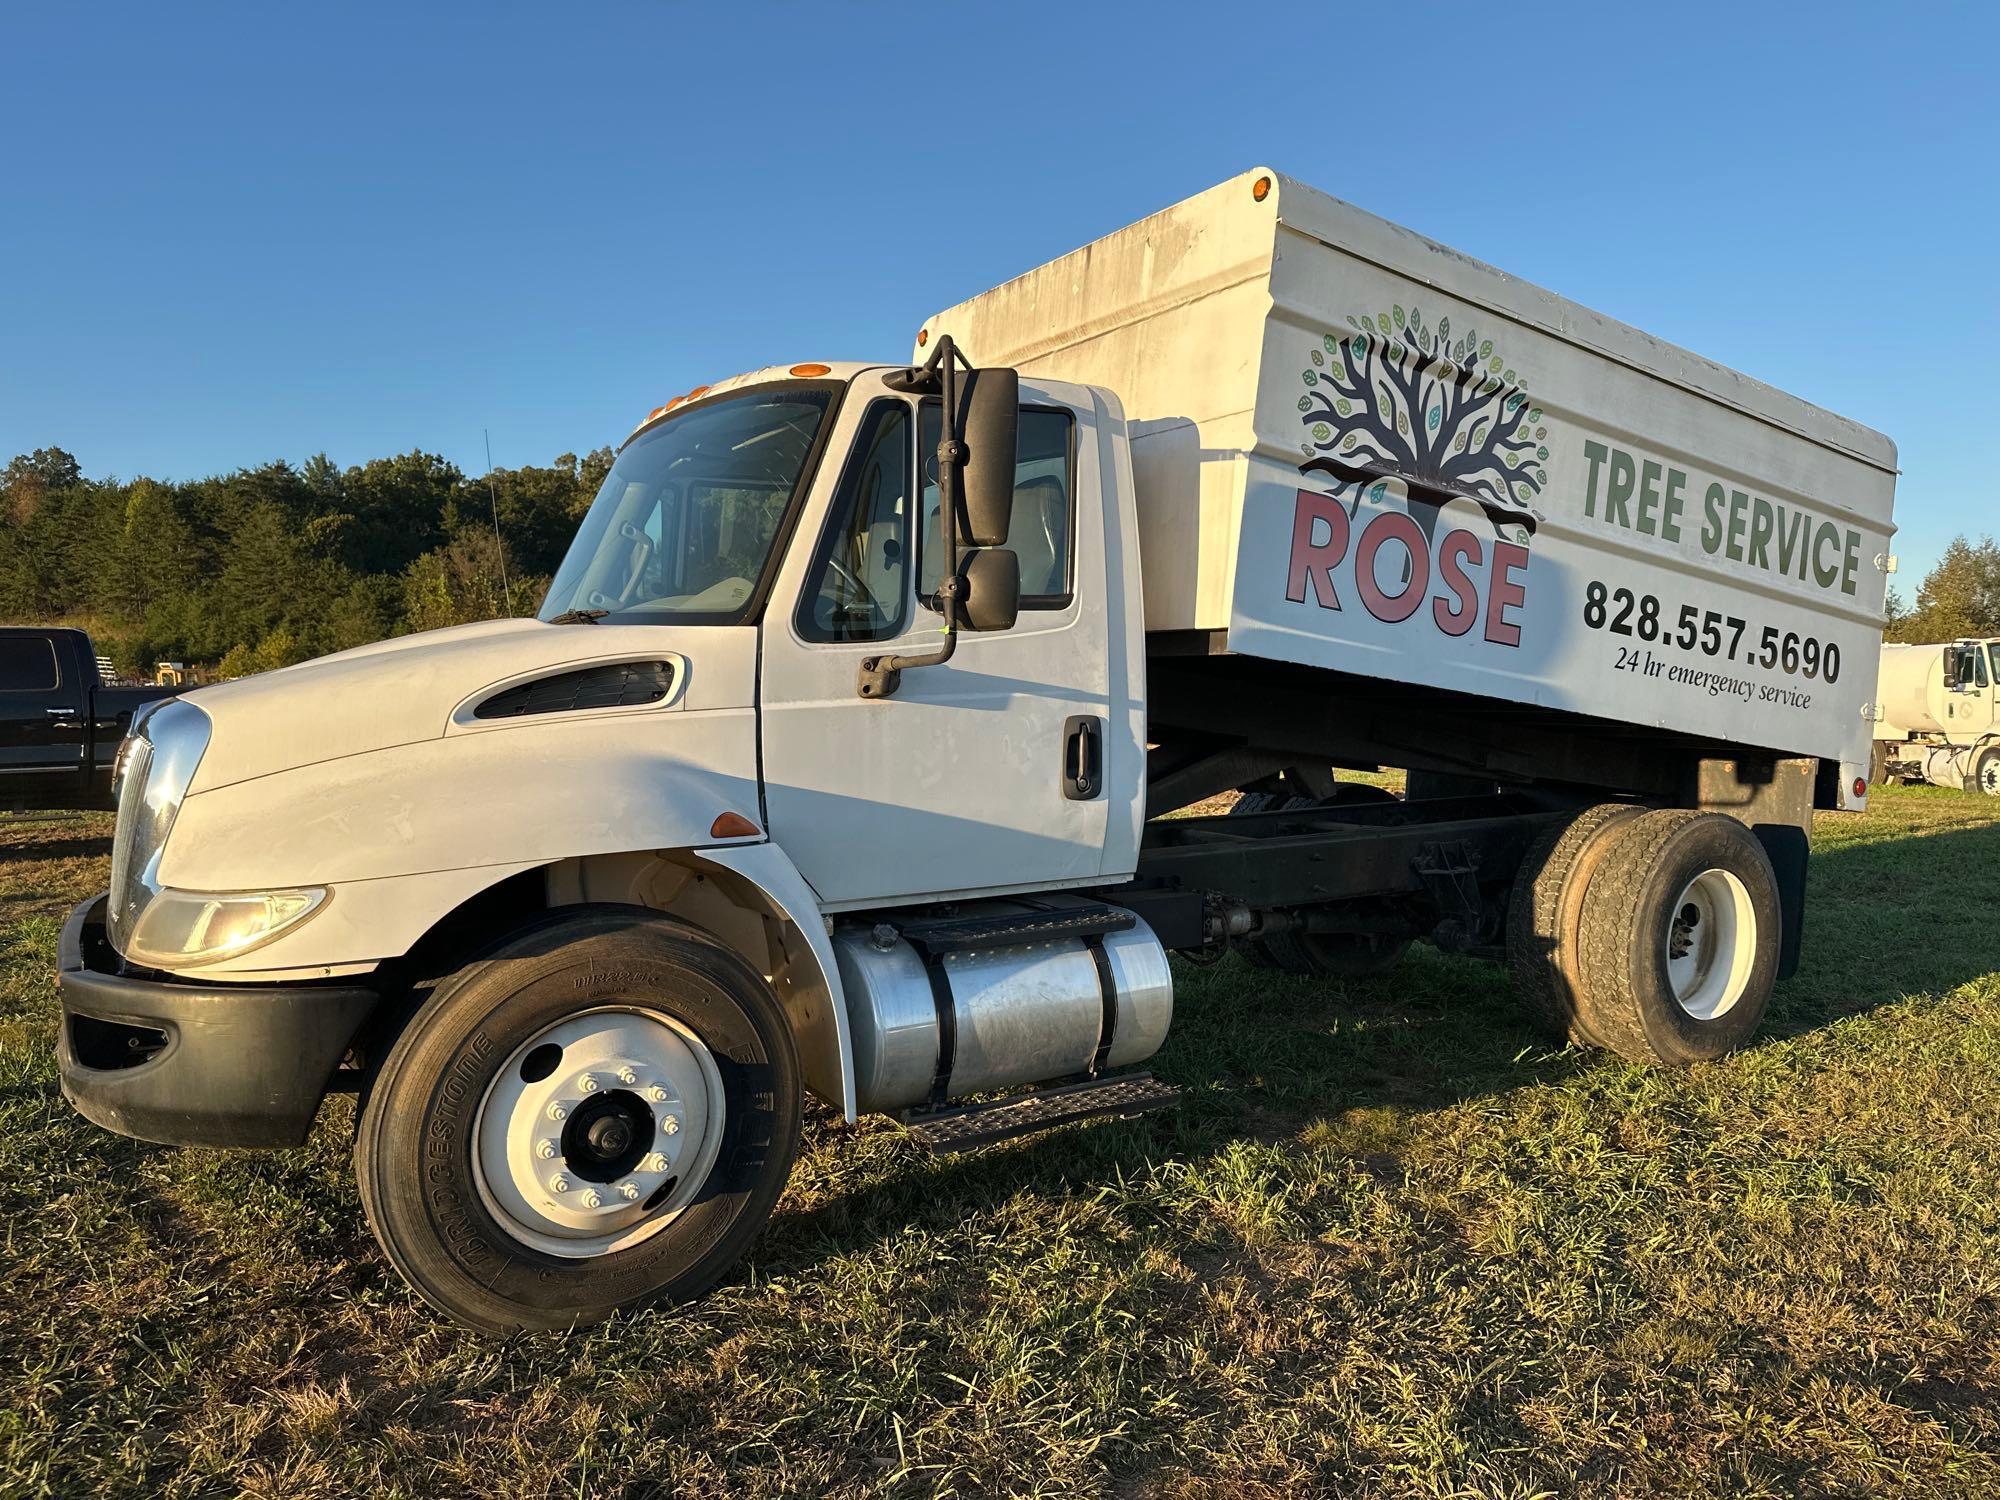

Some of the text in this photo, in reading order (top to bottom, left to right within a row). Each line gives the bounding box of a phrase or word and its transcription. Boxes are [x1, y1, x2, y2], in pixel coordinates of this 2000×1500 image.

[1285, 488, 1530, 647] ROSE
[1584, 439, 1861, 596] TREE SERVICE
[1583, 580, 1841, 684] 828.557.5690
[1614, 647, 1812, 710] 24 hr emergency service
[427, 1031, 495, 1267] BRIDGESTONE
